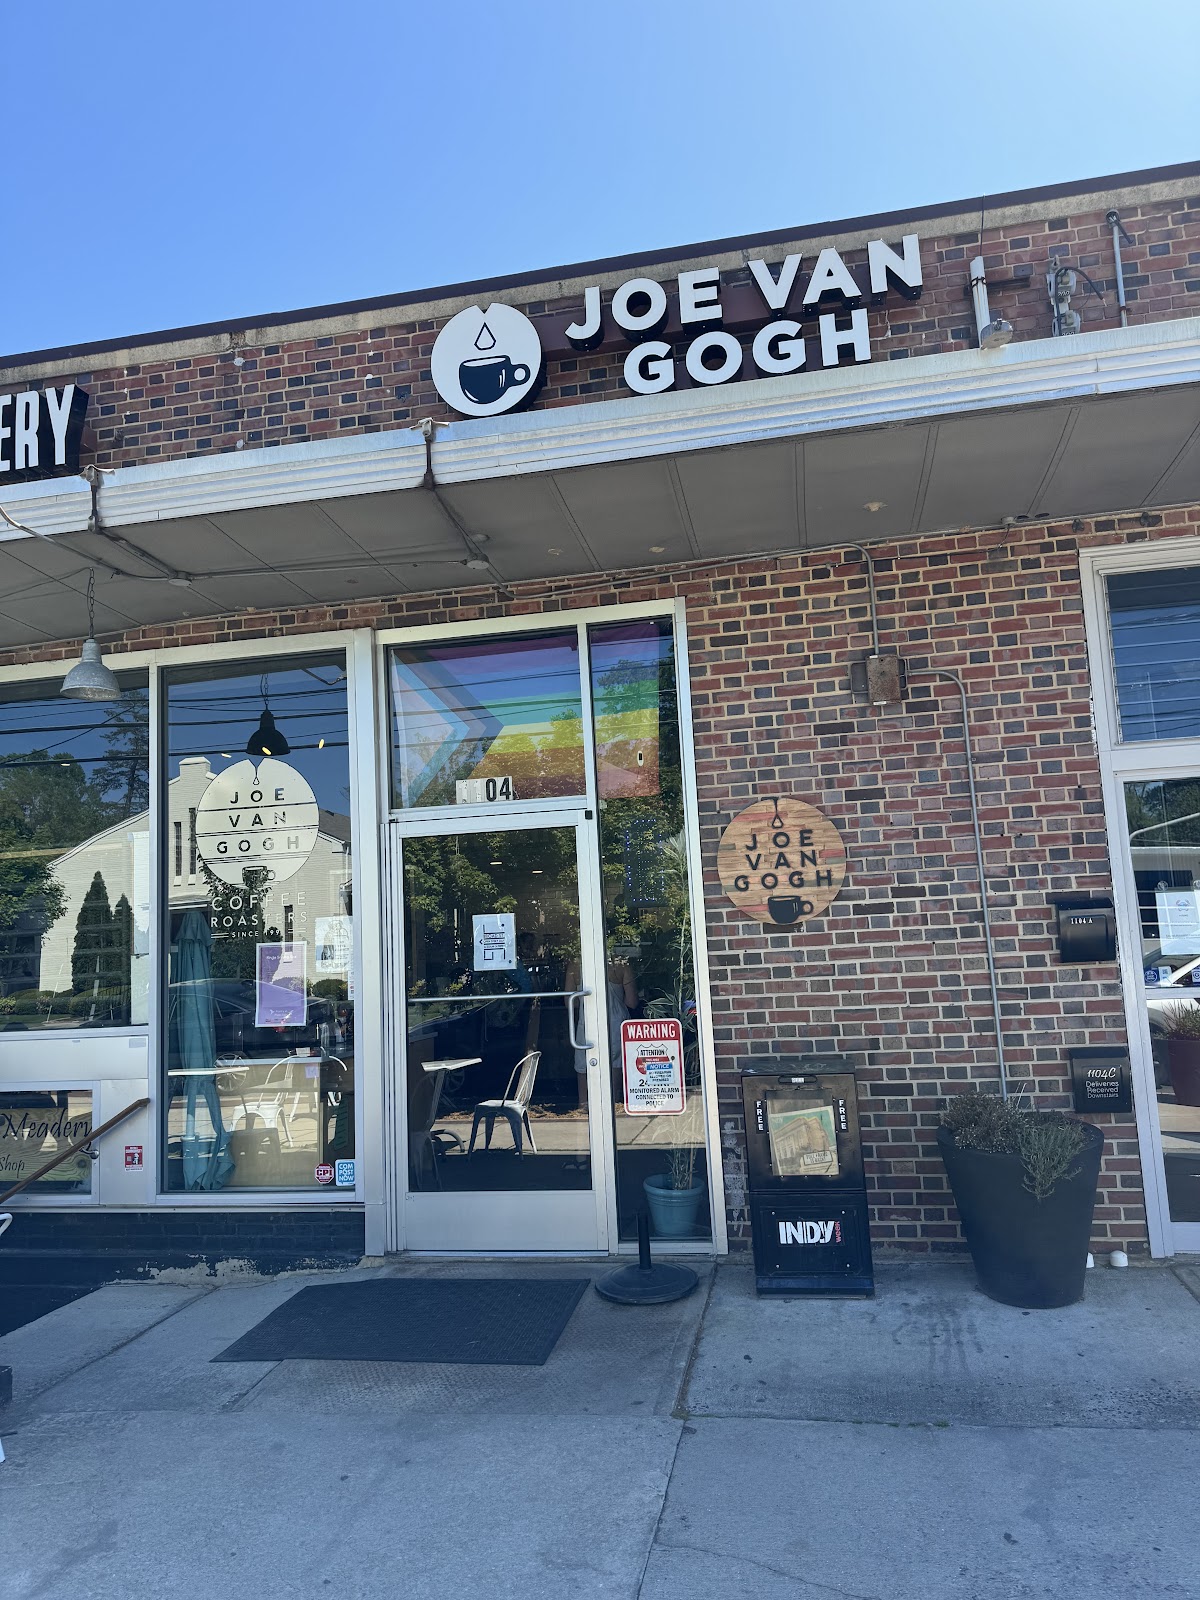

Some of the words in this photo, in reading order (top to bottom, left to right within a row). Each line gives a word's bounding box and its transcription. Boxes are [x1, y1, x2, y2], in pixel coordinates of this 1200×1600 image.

[565, 267, 722, 341] JOE
[747, 233, 923, 310] VAN
[623, 308, 872, 395] GOGH
[0, 384, 75, 472] ERY
[230, 788, 285, 804] JOE
[229, 811, 287, 828] VAN
[217, 836, 299, 854] GOGH
[745, 829, 814, 851] JOE
[745, 850, 817, 871] VAN
[734, 869, 832, 892] GOGH
[211, 892, 306, 911] COFFEE
[210, 911, 307, 928] ROASTERS
[231, 930, 259, 938] SINCE
[627, 1023, 676, 1039] WARNING
[1085, 1080, 1120, 1088] Deliveries
[756, 1100, 764, 1131] FREE
[838, 1099, 847, 1130] FREE
[1, 1108, 93, 1150] Meadery
[778, 1220, 835, 1244] INDY
